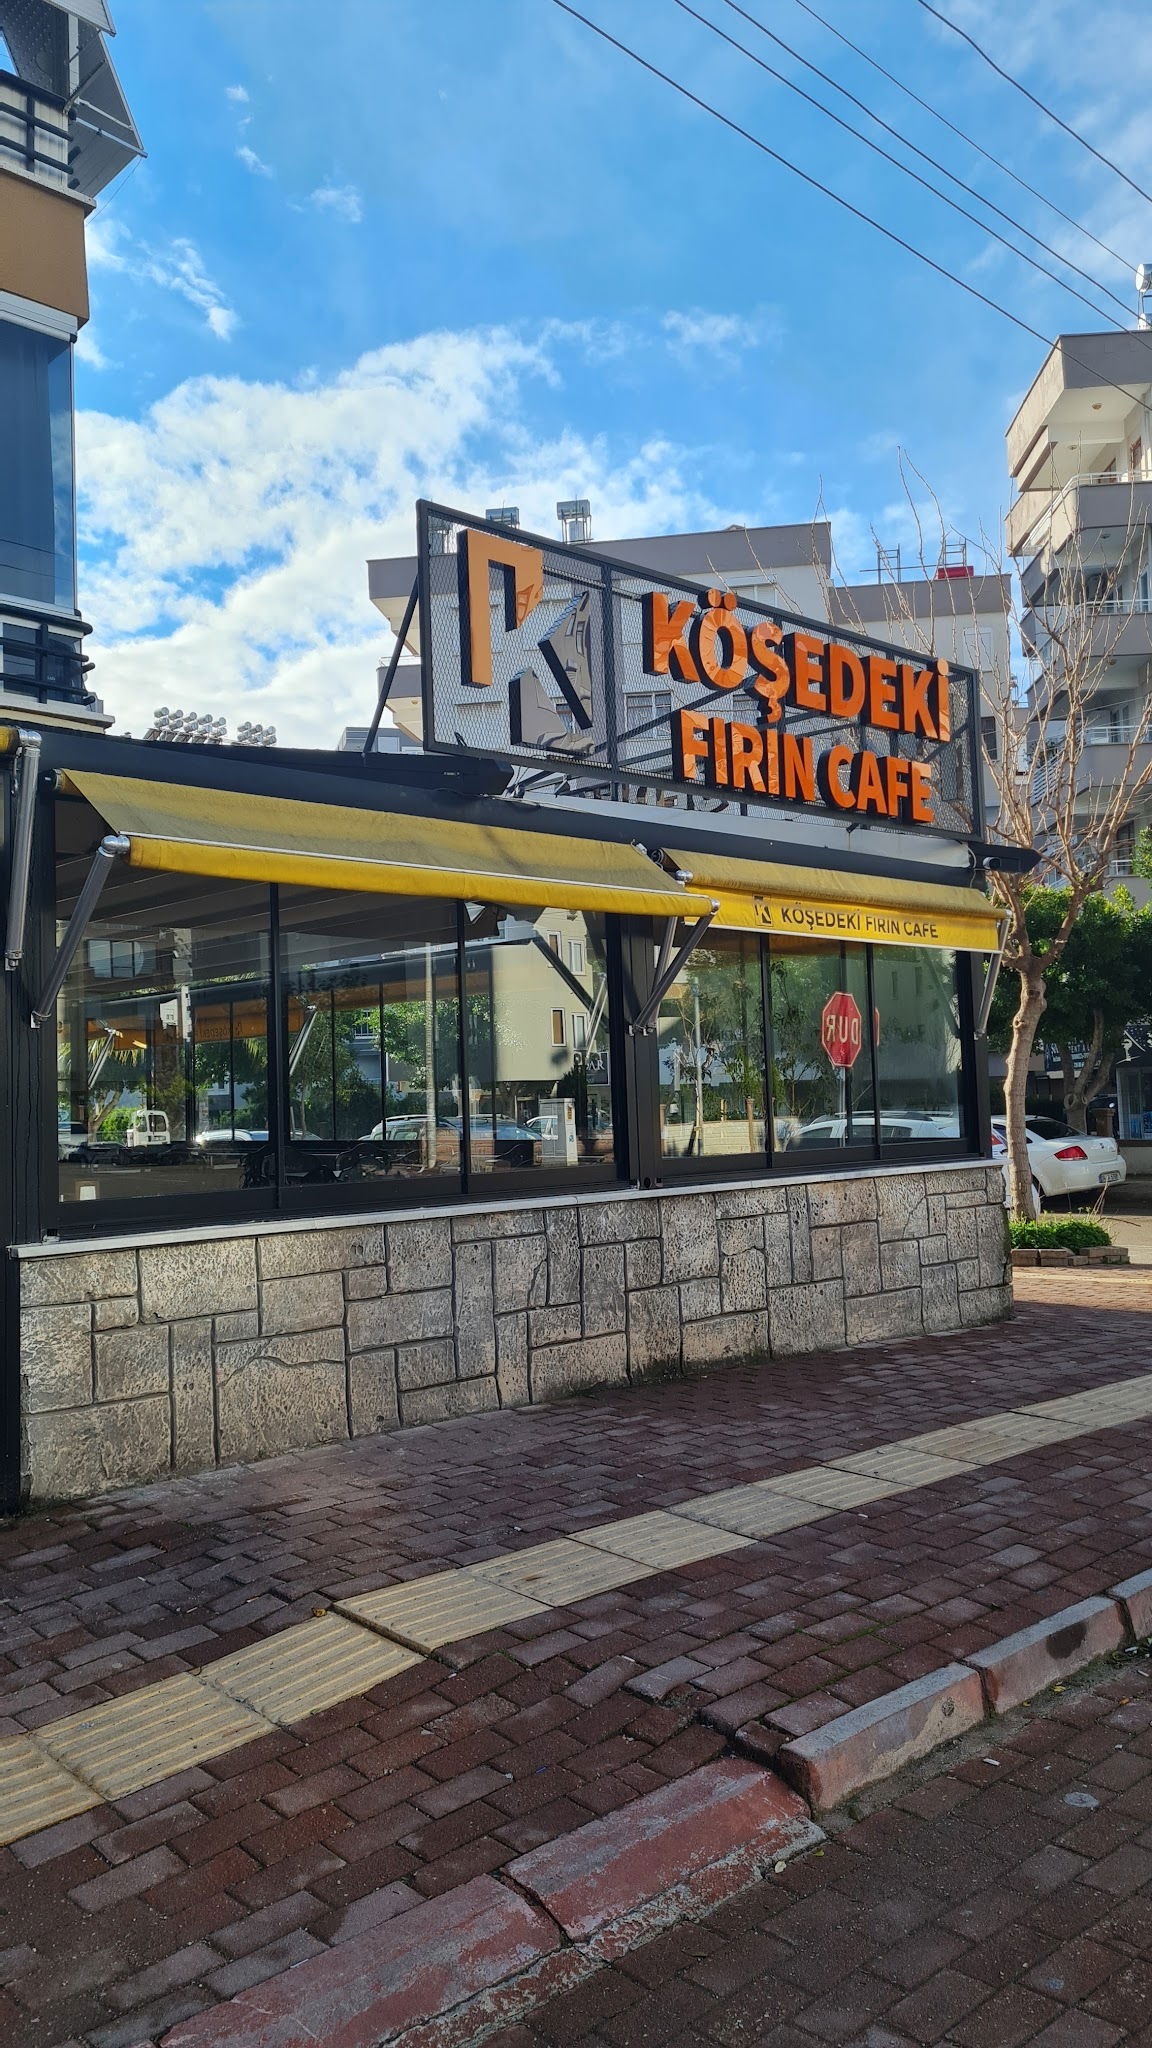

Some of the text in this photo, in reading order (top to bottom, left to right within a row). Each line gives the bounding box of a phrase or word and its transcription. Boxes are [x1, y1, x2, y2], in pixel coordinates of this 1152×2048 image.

[645, 588, 951, 742] KÖŞEDEKİ
[675, 708, 935, 823] FIRIN CAFE
[781, 901, 861, 930] KÖŞEDEKİ
[866, 916, 901, 934] FIRIN
[903, 921, 938, 938] CAFE
